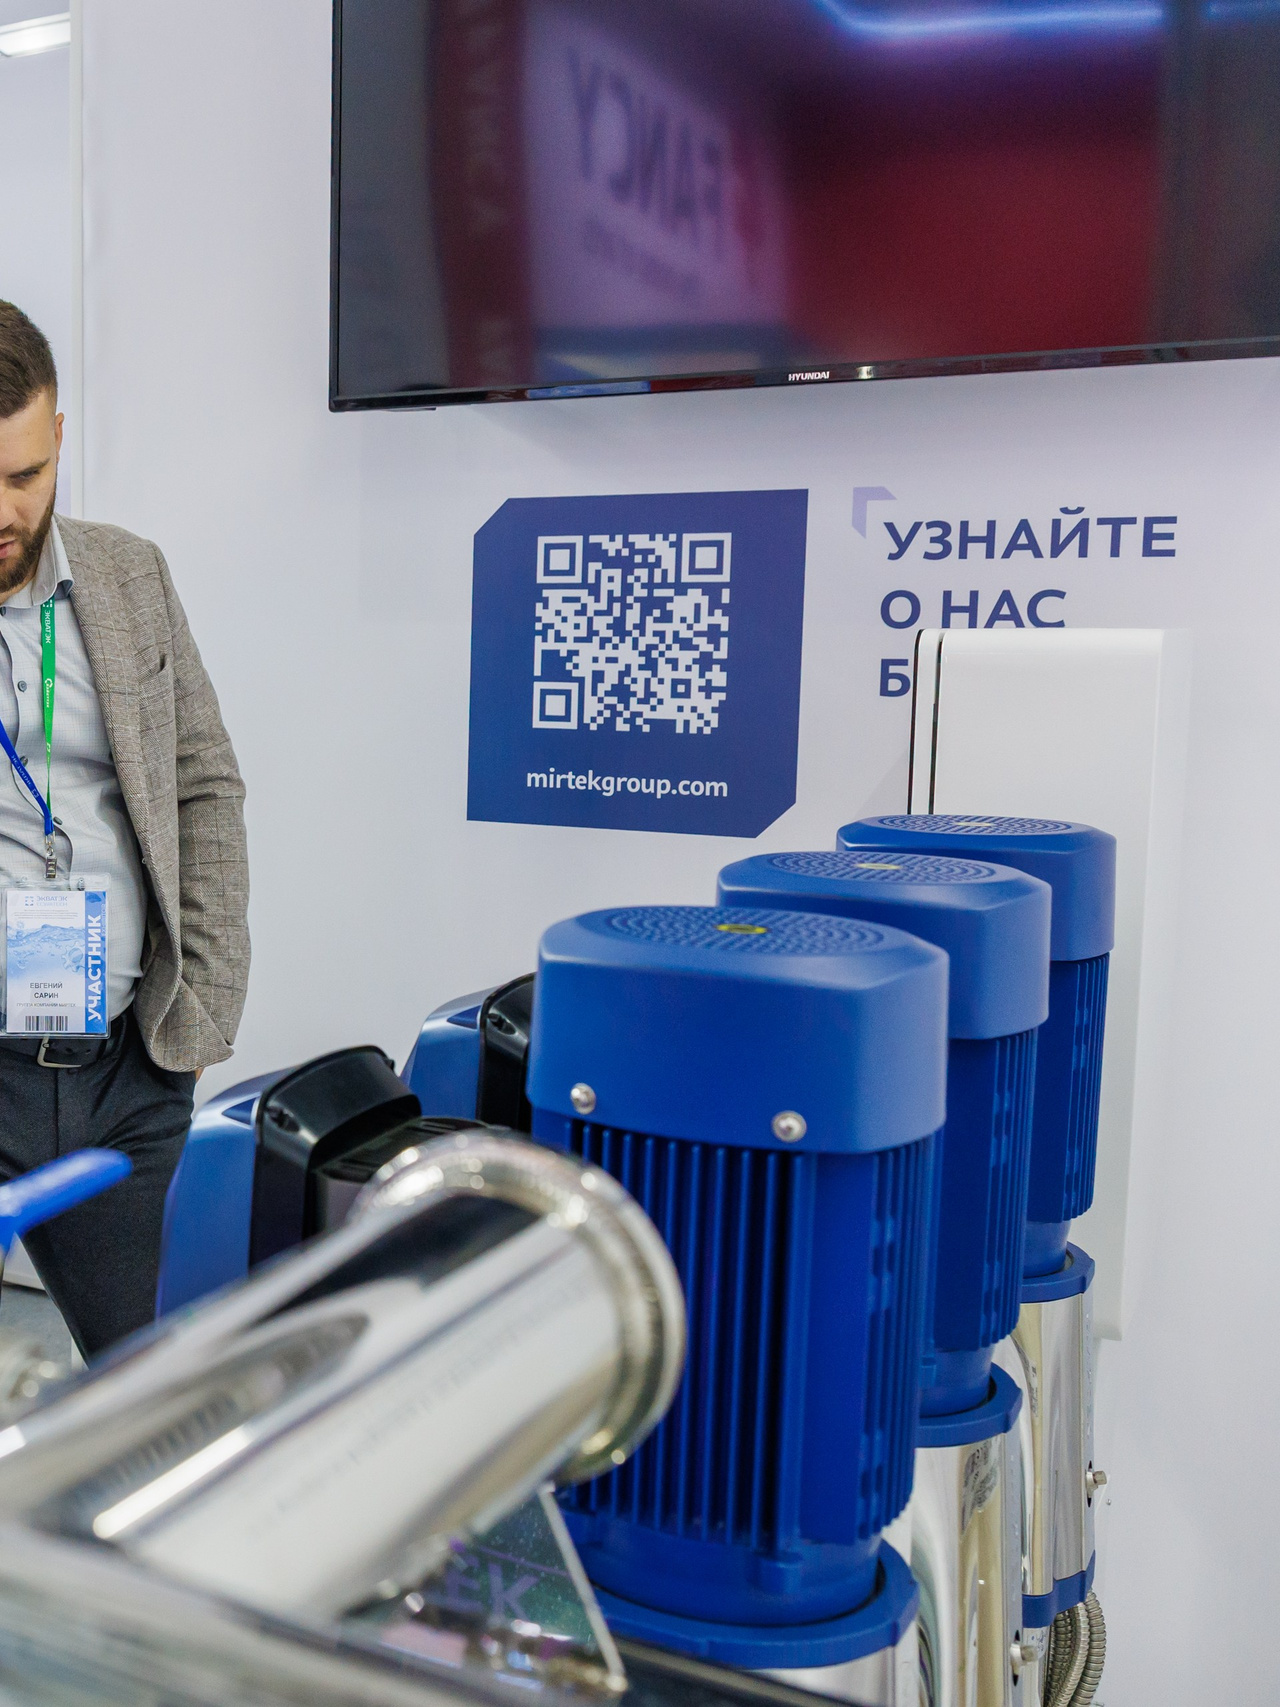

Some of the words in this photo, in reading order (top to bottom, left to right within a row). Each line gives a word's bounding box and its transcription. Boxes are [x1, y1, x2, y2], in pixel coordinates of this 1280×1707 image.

[788, 371, 830, 381] HYUNDAI
[884, 506, 1177, 560] УЗНАЙТЕ
[880, 589, 921, 629] О
[941, 588, 1067, 628] НАС
[526, 767, 728, 799] mirtekgroup.com
[29, 981, 63, 989] ЕВГЕНИЙ
[88, 914, 102, 1022] УЧАСТНИК
